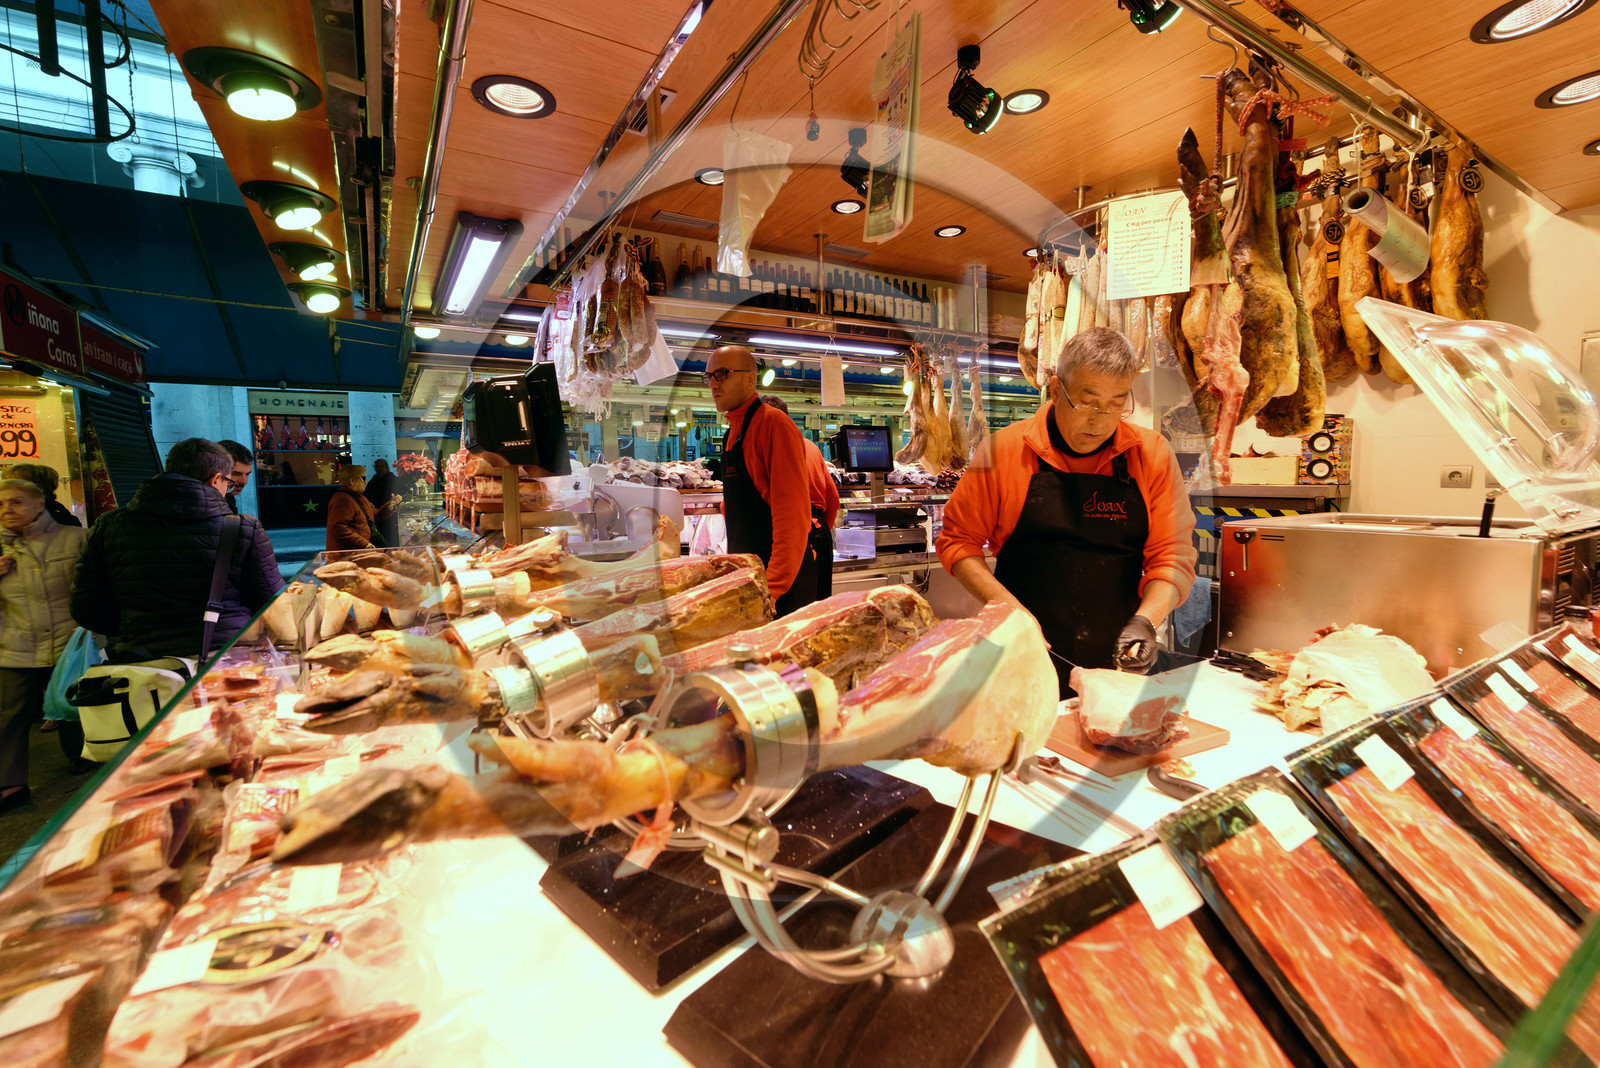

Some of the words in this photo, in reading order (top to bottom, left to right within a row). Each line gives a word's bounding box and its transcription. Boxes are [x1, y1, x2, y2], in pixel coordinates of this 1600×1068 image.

[47, 338, 77, 368] Carns
[84, 340, 113, 366] aviram
[0, 405, 31, 414] STEC
[259, 397, 344, 409] HOMENAJE
